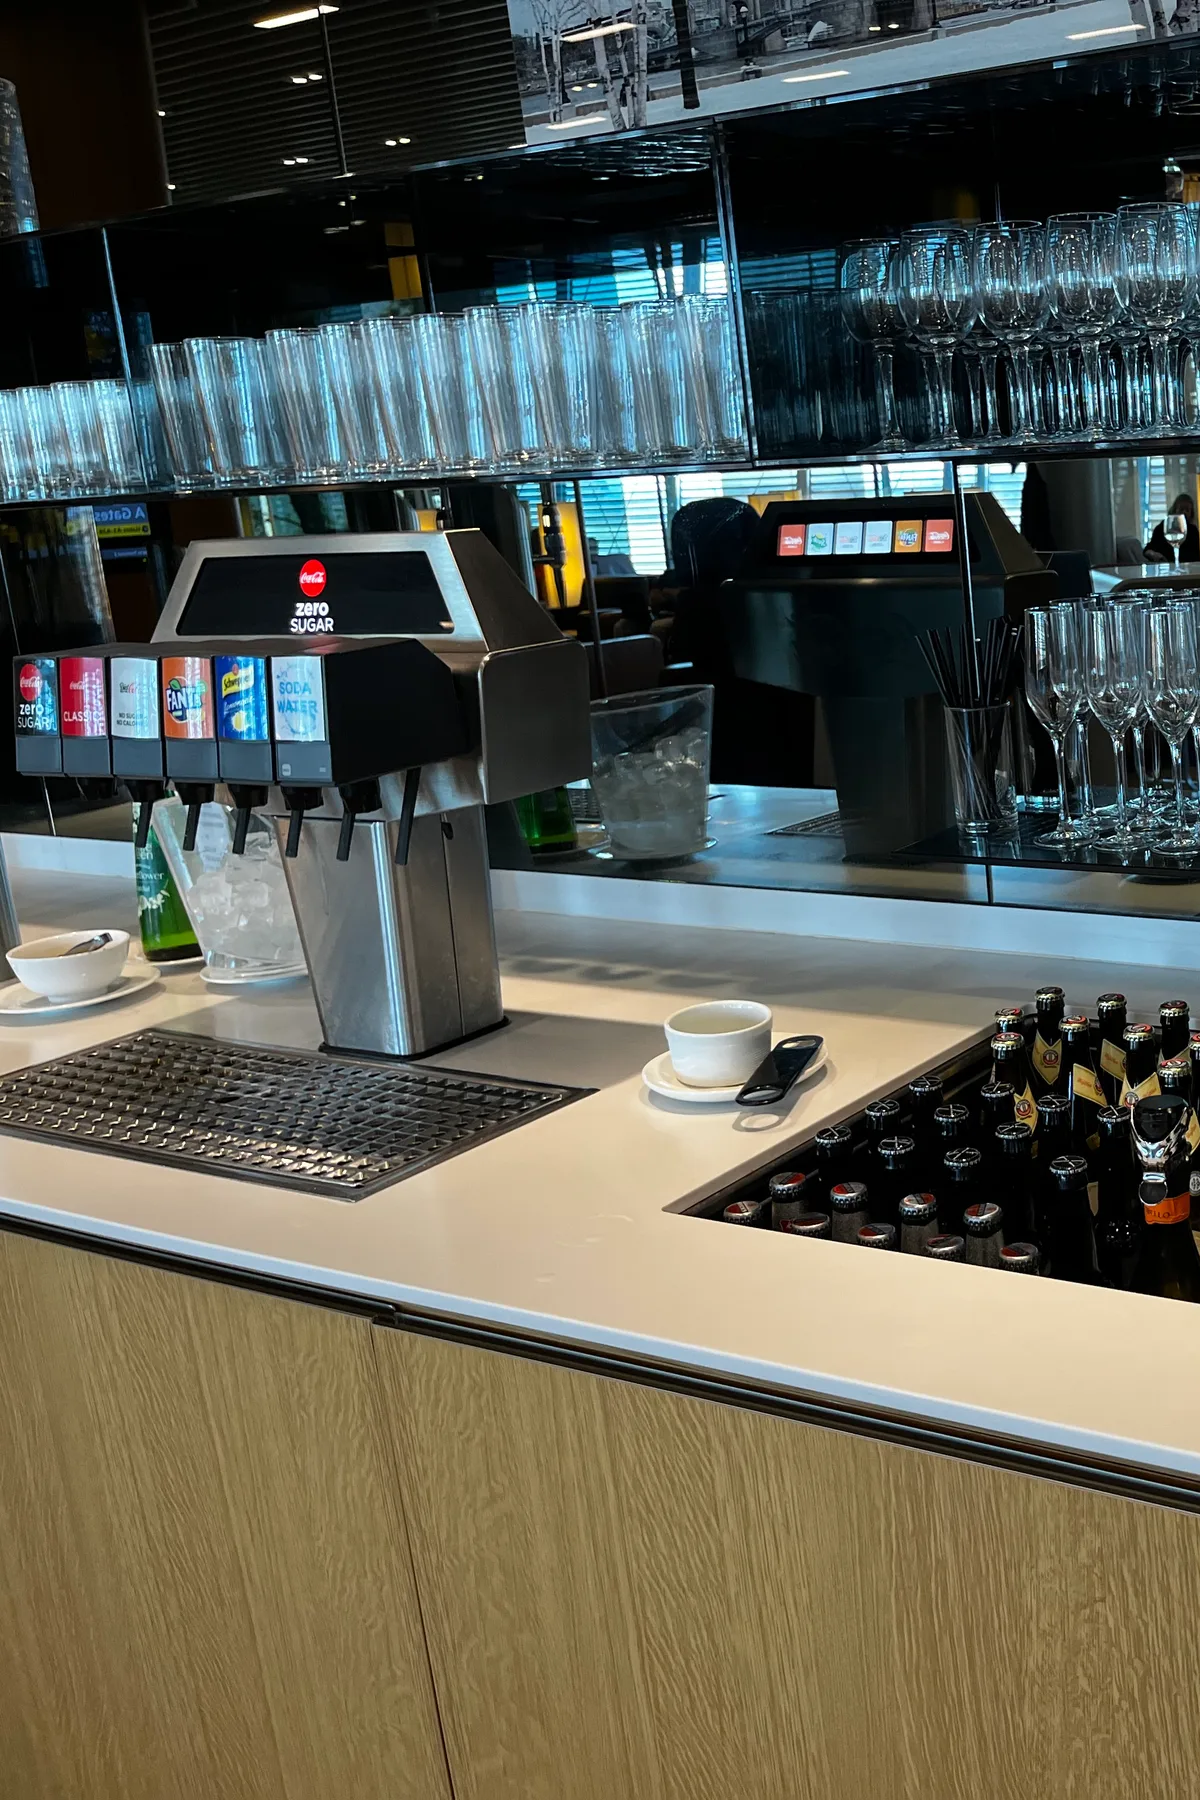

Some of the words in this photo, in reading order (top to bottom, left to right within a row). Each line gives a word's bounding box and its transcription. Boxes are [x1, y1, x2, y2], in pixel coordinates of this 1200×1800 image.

[300, 571, 325, 584] Coca-Cola
[295, 602, 330, 616] zero
[290, 617, 334, 632] SUGAR
[278, 681, 312, 695] SODA
[19, 703, 44, 716] zero
[276, 700, 318, 713] WATER
[17, 716, 50, 729] SUGAR
